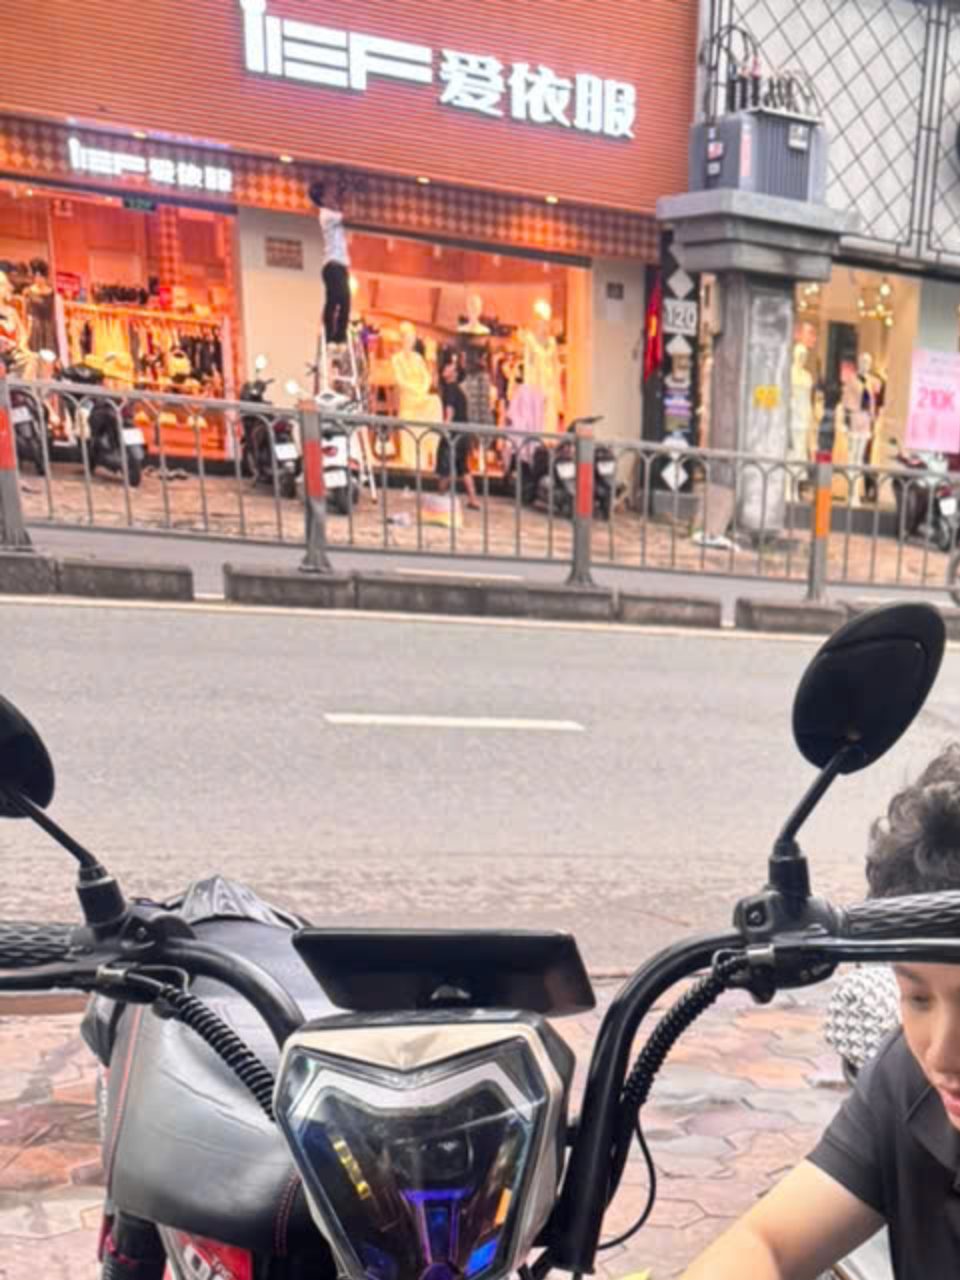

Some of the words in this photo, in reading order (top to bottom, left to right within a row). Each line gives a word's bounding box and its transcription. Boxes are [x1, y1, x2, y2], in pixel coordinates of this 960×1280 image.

[439, 48, 636, 139] 爱依服
[667, 303, 697, 331] 120
